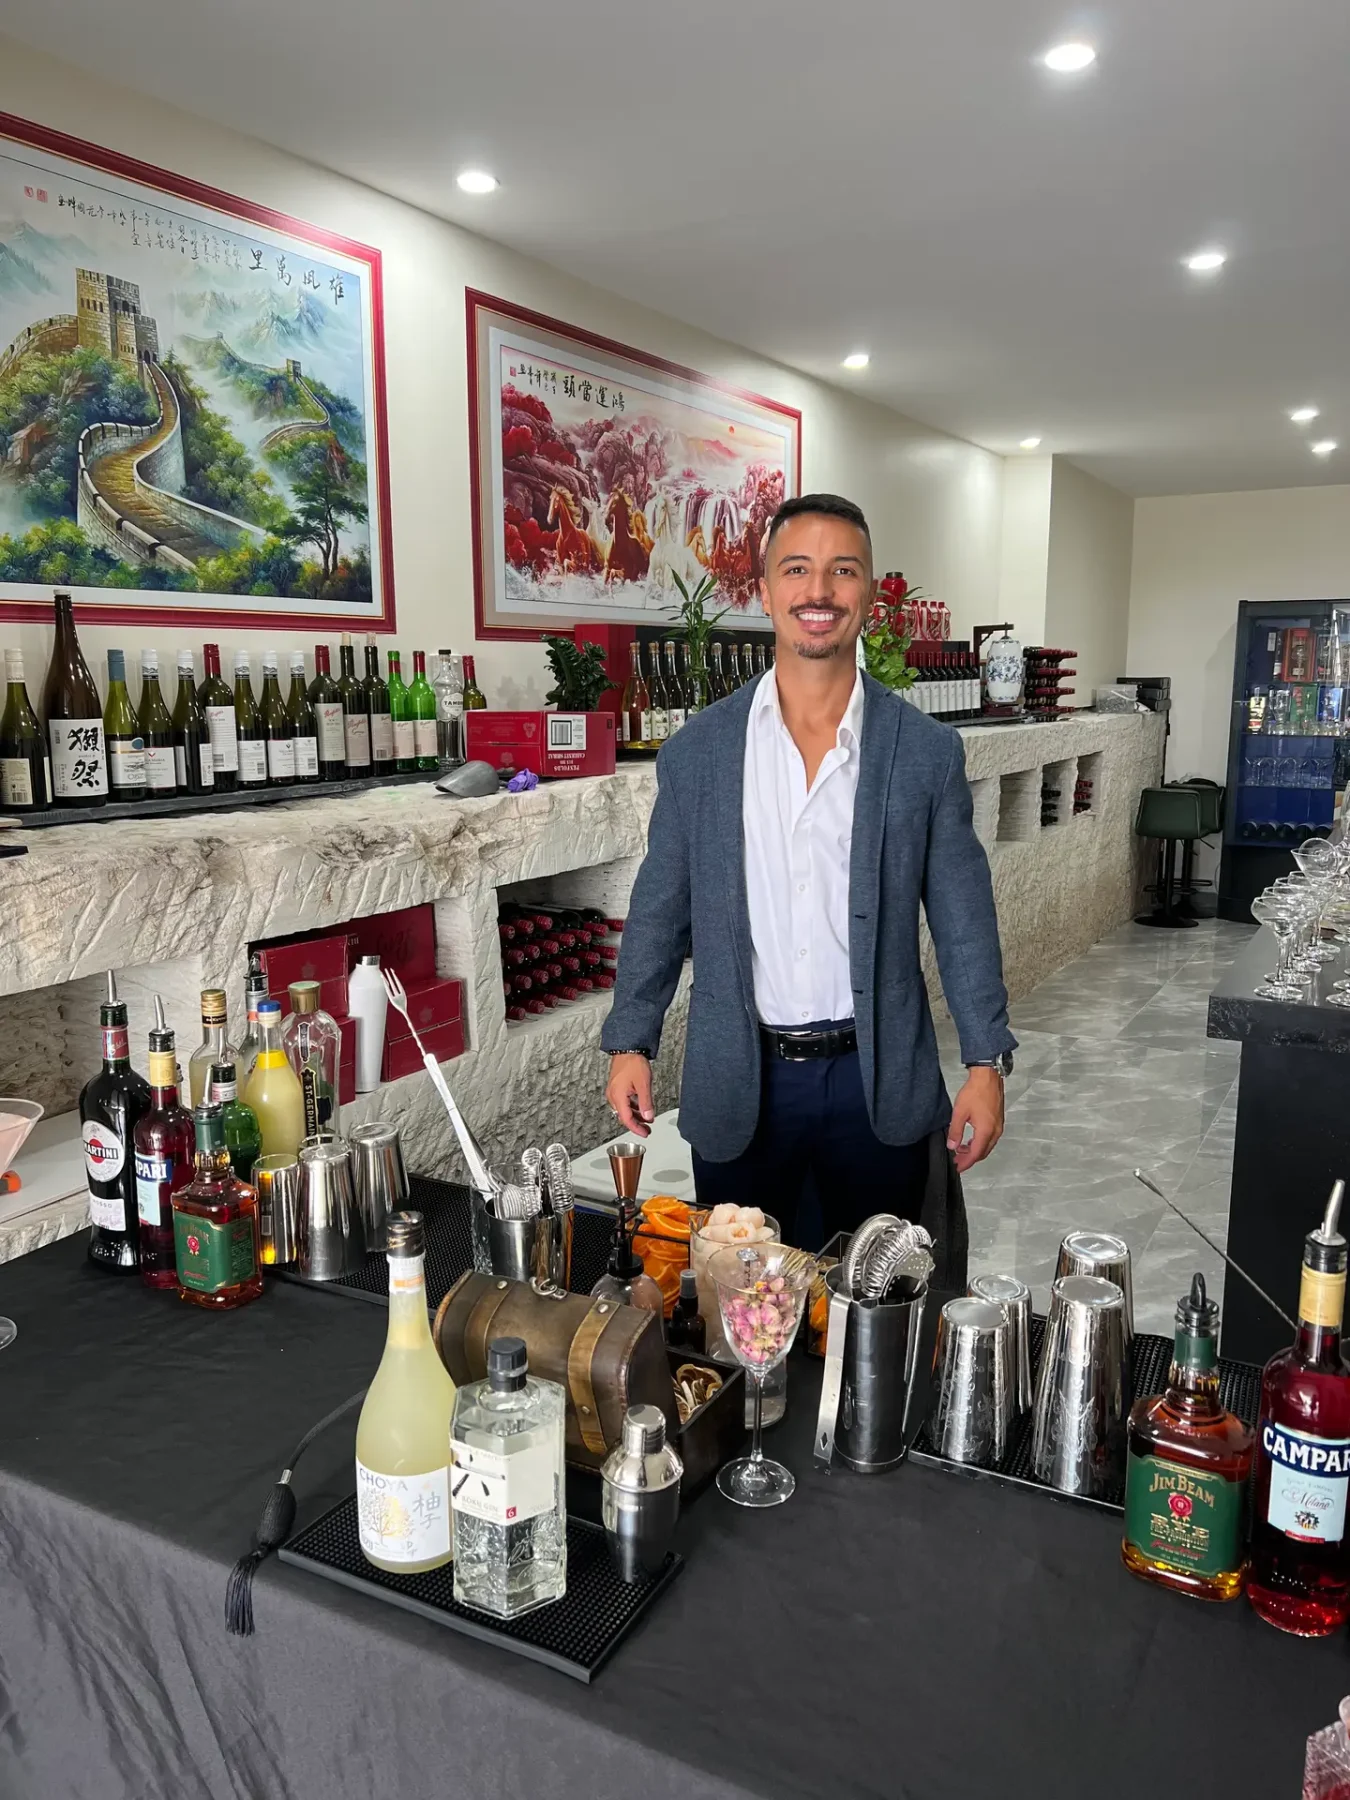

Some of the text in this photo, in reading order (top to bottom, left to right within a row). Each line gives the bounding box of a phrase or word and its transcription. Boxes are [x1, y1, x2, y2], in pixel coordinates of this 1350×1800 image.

[136, 1161, 167, 1179] PARI
[359, 1467, 409, 1492] CHOYA
[1149, 1472, 1216, 1509] JIM BEAM
[1150, 1512, 1210, 1539] RYE
